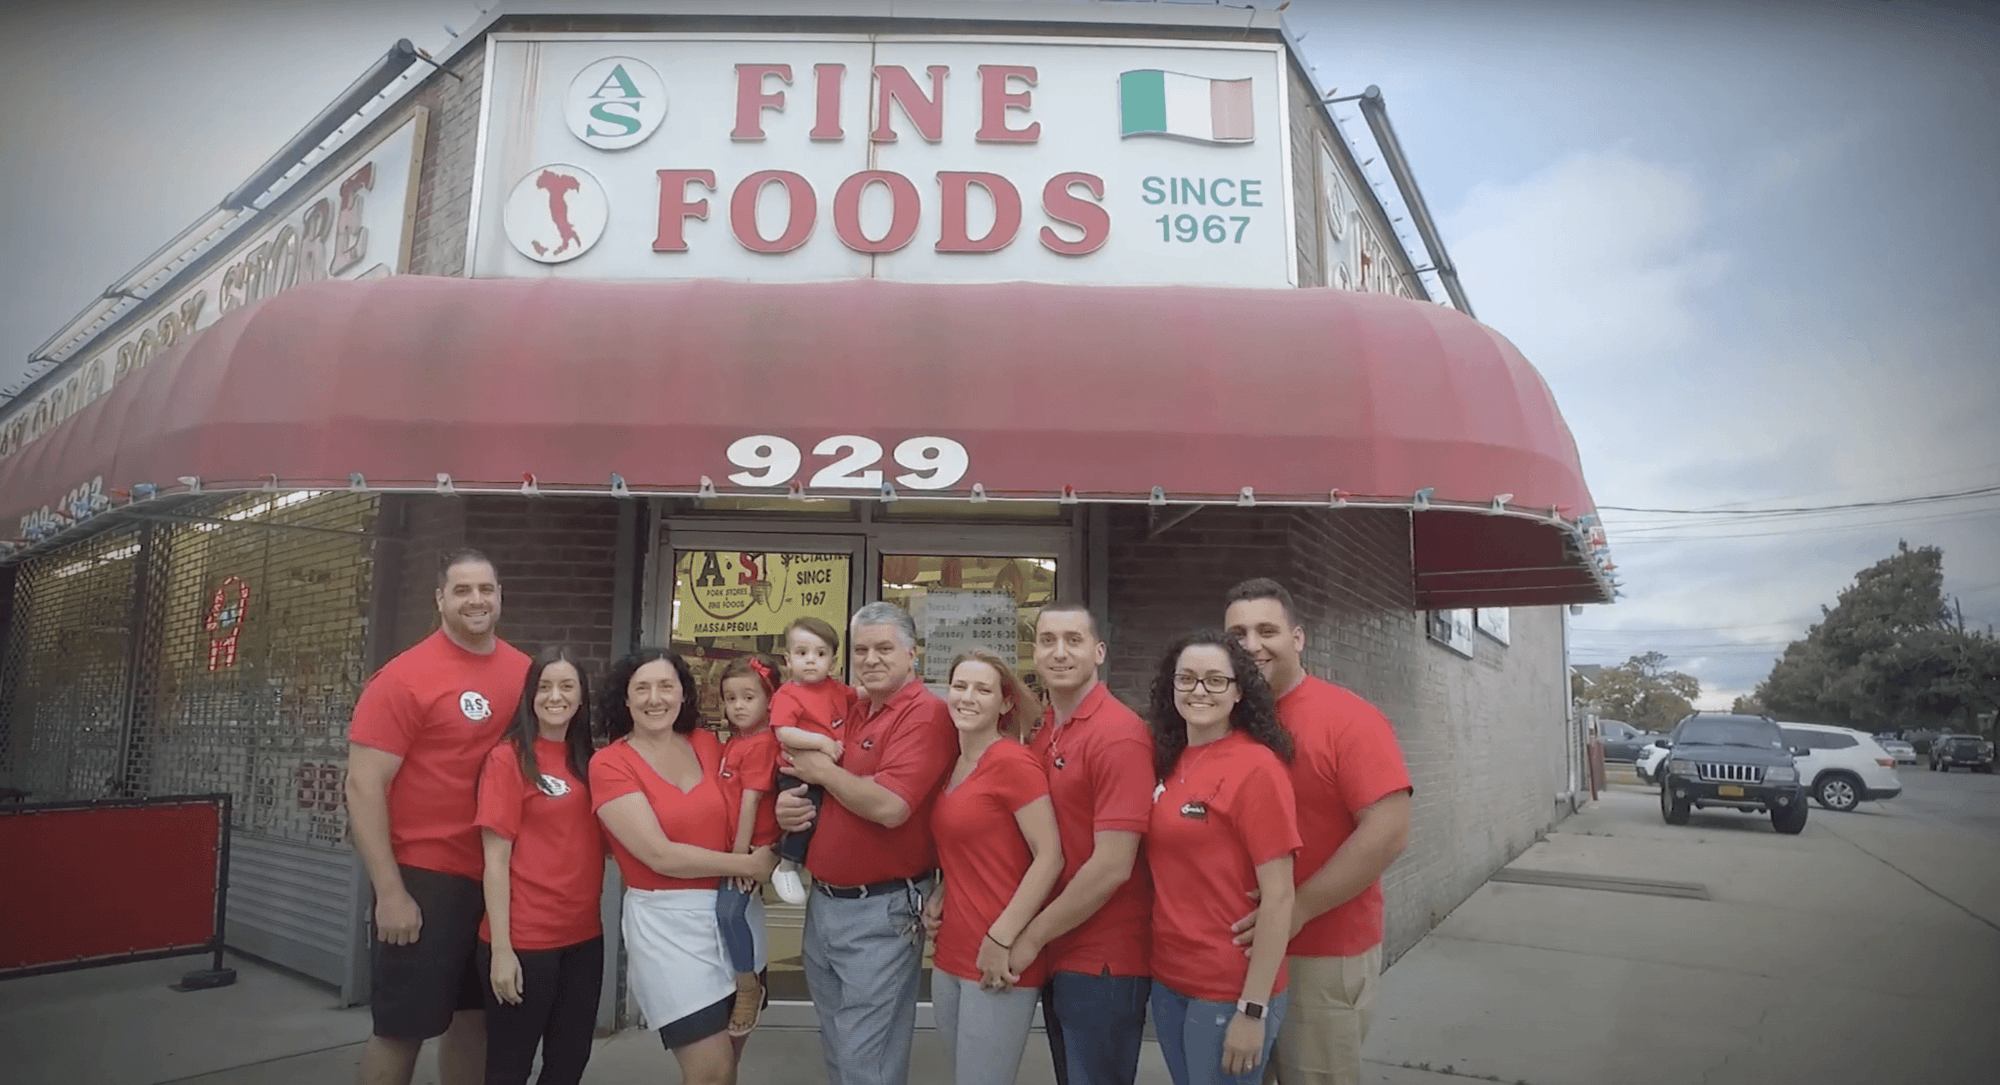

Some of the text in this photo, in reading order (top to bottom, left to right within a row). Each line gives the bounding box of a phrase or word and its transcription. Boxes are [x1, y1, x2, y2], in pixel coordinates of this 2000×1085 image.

[730, 63, 1042, 143] FINE
[1141, 176, 1263, 207] SINCE
[652, 169, 1111, 255] FOODS
[1155, 214, 1251, 244] 1967
[726, 434, 969, 490] 929
[797, 569, 831, 585] SINCE
[707, 588, 747, 597] PORK STORES
[801, 591, 826, 607] 1967
[723, 601, 744, 609] FOODS
[694, 621, 758, 633] MASSAPEQUA
